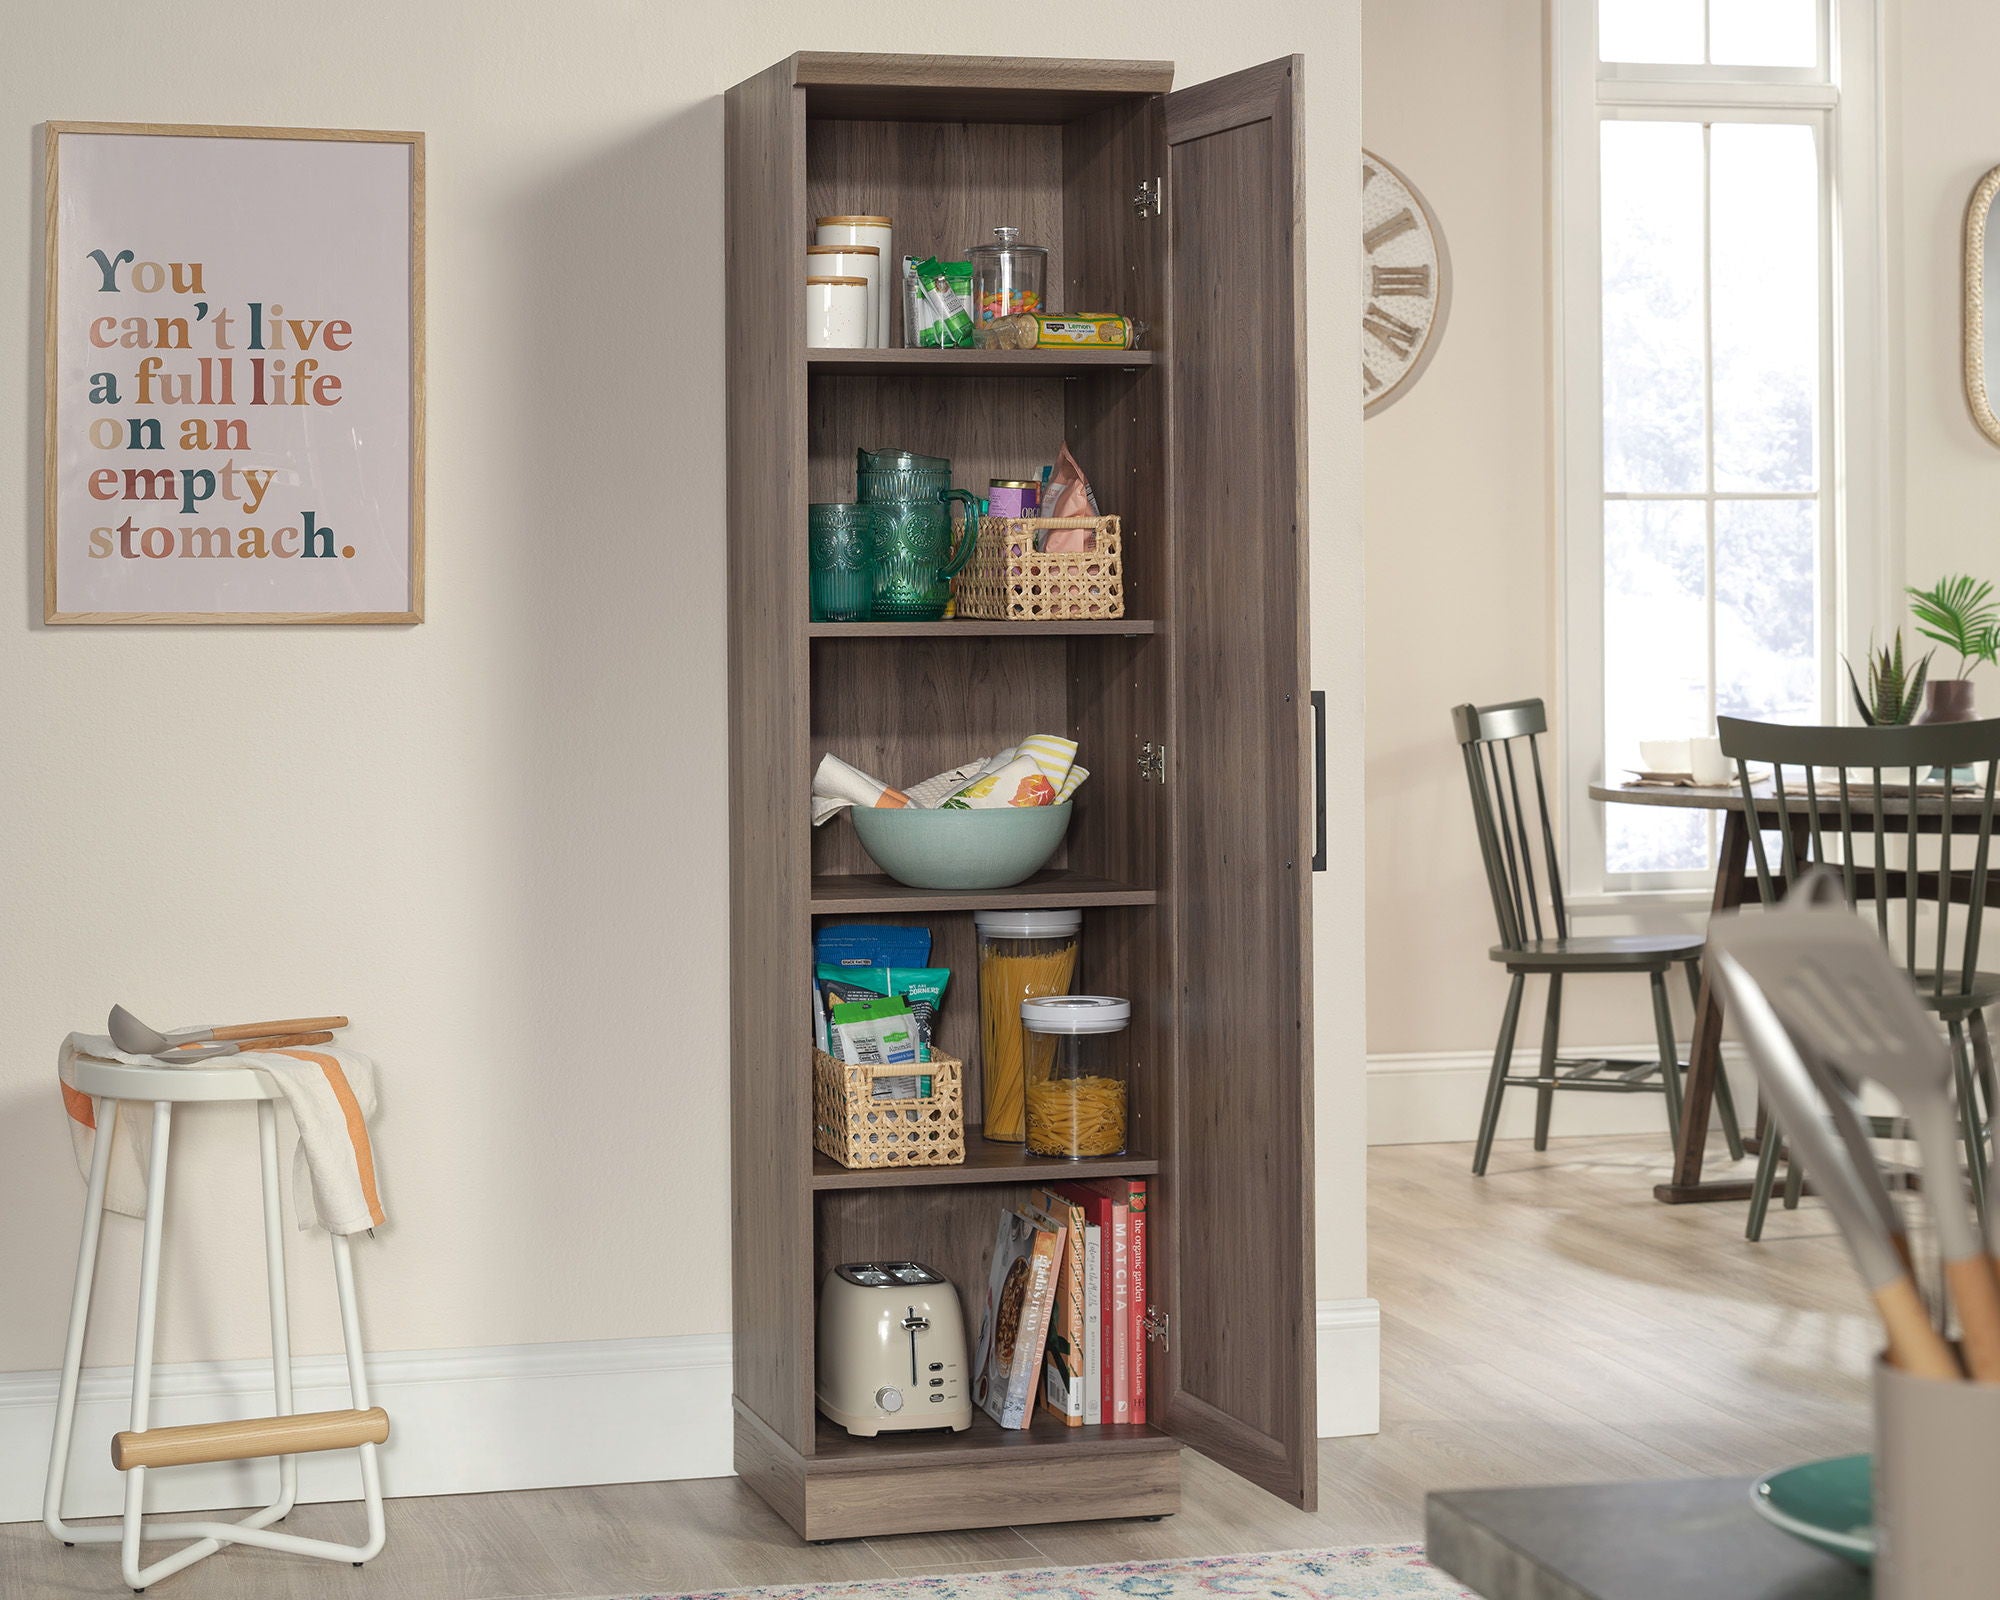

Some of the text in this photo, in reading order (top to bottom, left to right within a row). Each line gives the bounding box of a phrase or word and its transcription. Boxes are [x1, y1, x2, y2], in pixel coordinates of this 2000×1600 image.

[87, 249, 206, 294] You
[89, 302, 353, 351] can't live
[88, 357, 343, 407] a full life
[89, 418, 252, 450] on an
[87, 458, 277, 514] empty
[88, 511, 356, 560] stomach.
[1074, 1217, 1083, 1234] THE
[1074, 1239, 1083, 1282] INSPIRED
[1114, 1223, 1127, 1312] MATCHA
[1132, 1219, 1144, 1303] the organic garden
[1026, 1299, 1041, 1332] ITALY
[1073, 1287, 1083, 1350] HOUSEPLANT
